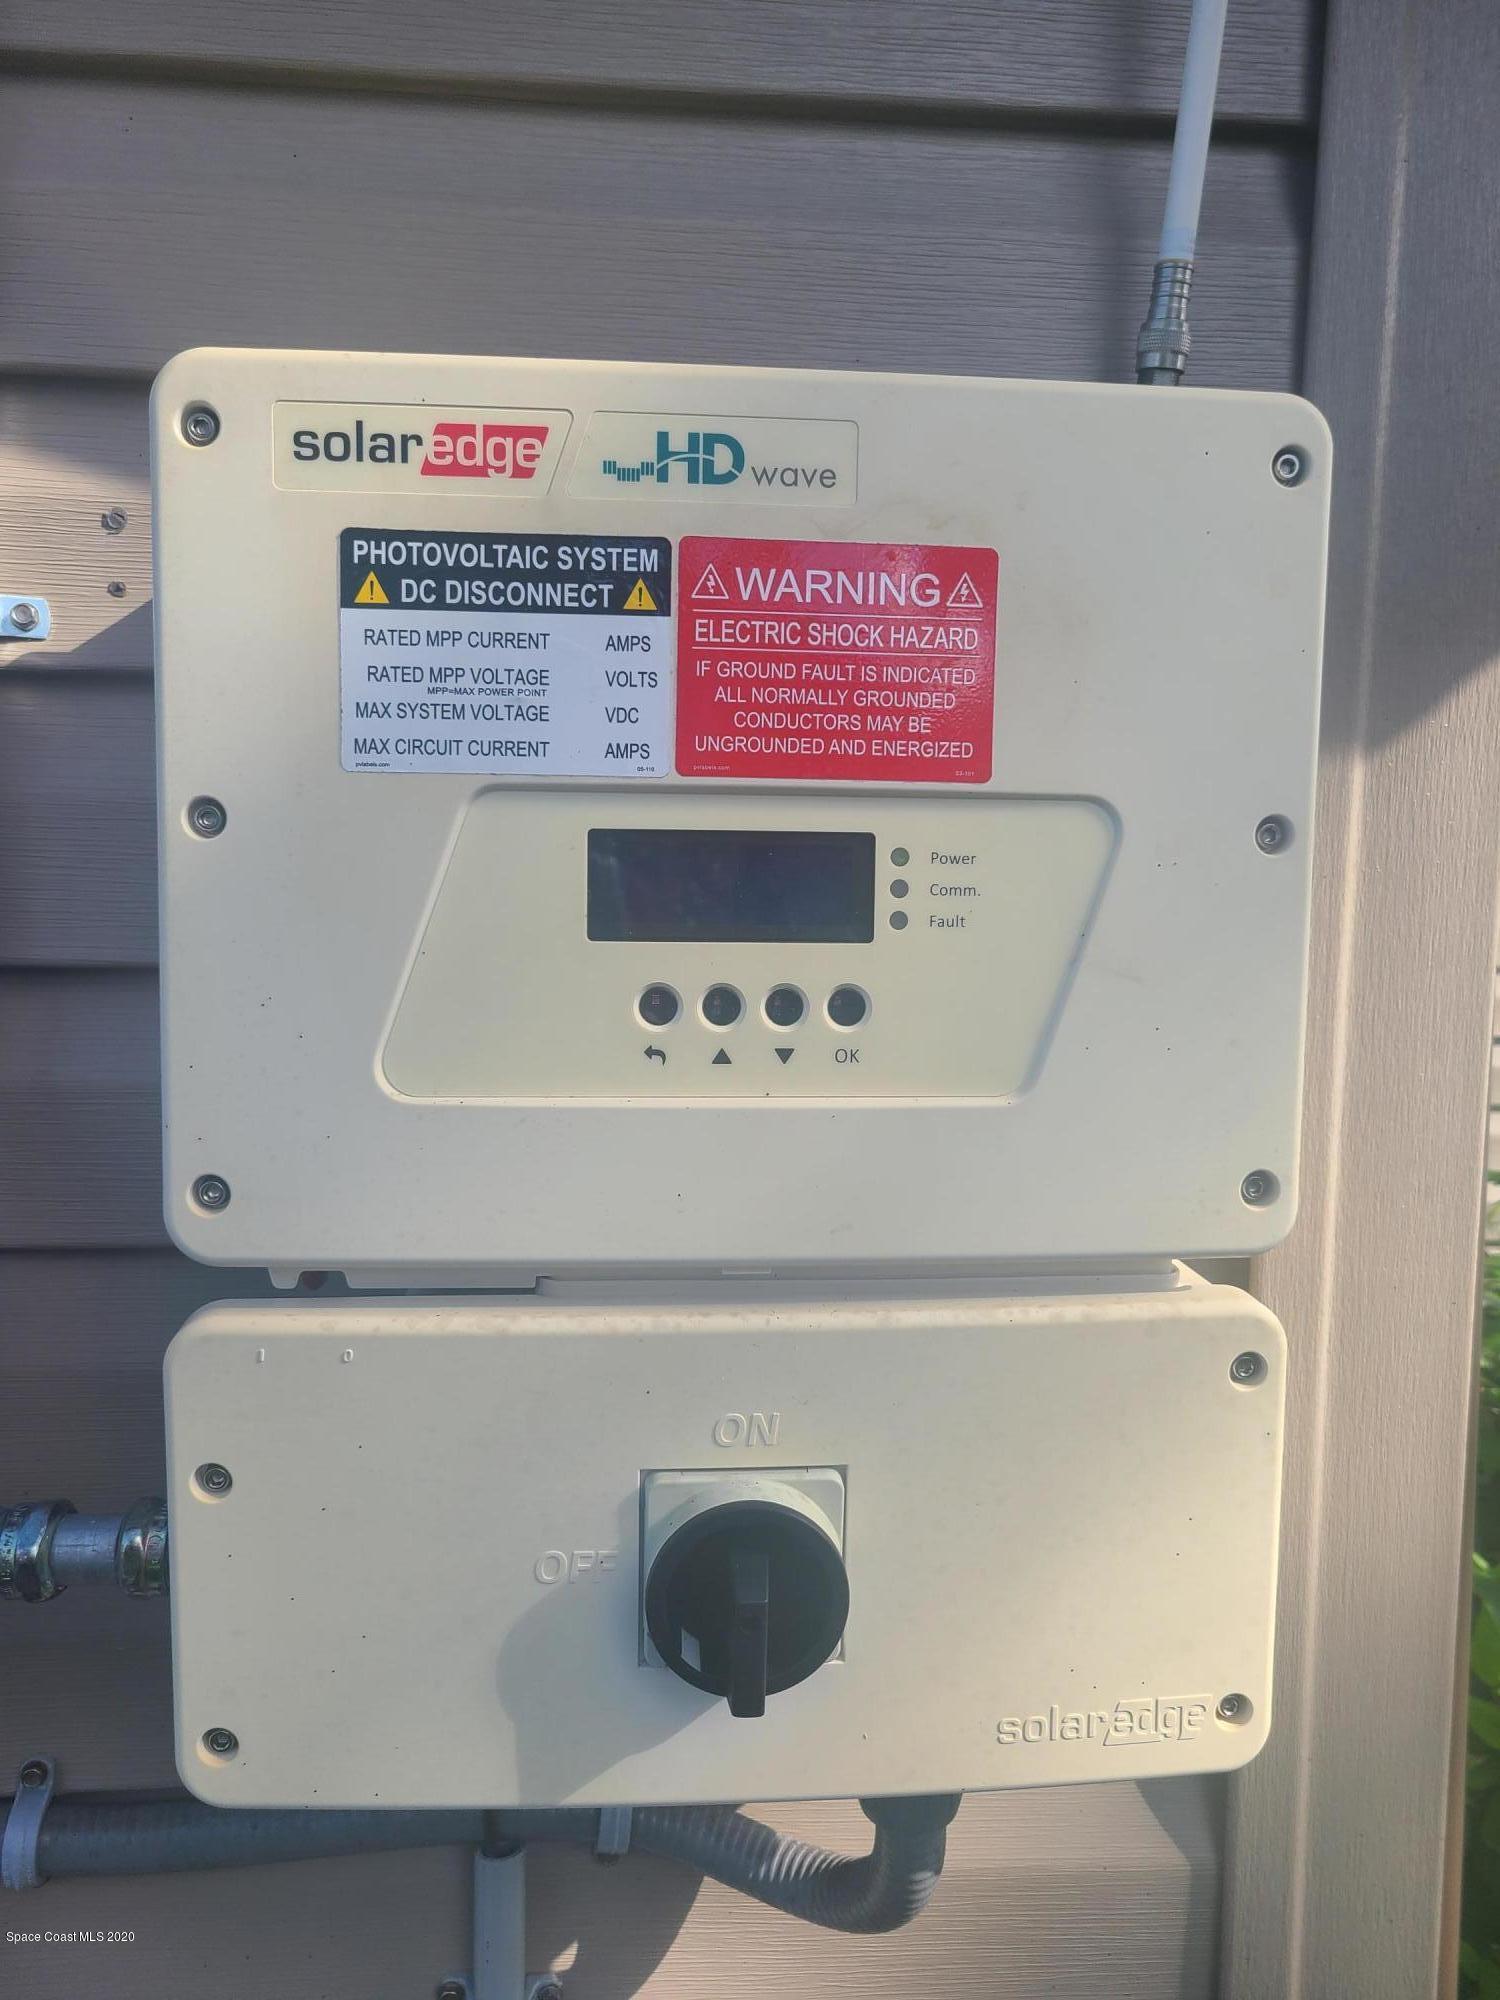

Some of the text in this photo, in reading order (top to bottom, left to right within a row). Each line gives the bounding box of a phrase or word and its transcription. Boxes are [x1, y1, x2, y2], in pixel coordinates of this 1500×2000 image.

[292, 420, 543, 478] solaredge
[656, 431, 838, 489] HD wave
[353, 540, 658, 573] PHOTOVOLTAIC SYSTEM
[400, 578, 614, 608] DC DISCONNECT
[735, 567, 941, 608] WARNING
[363, 628, 651, 652] RATED MPP CURRENT AMPS
[695, 619, 978, 650] ELECTRIC SHOCK HAZARD
[367, 665, 658, 688] RATED MPP VOLTAGE VOLTS
[696, 660, 976, 685] IF GROUND FAULT IS INDICATED
[427, 687, 547, 697] MPP=MAX POWER POINT
[714, 686, 956, 709] ALL NORMALLY GROUNDED
[355, 702, 639, 723] MAX SYSTEM VOLTAGE VDC
[734, 711, 932, 733] CONDUCTORS MAY BE
[354, 737, 650, 759] MAX CIRCUIT CURRENT AMPS
[695, 735, 973, 758] UNGROUNDED AND ENERGIZED
[930, 851, 977, 865] Power
[930, 883, 981, 897] Comm.
[929, 915, 966, 928] Fault
[835, 1048, 860, 1064] OK
[712, 1411, 782, 1448] ON
[534, 1549, 620, 1584] OFF
[997, 1698, 1207, 1745] solaredge
